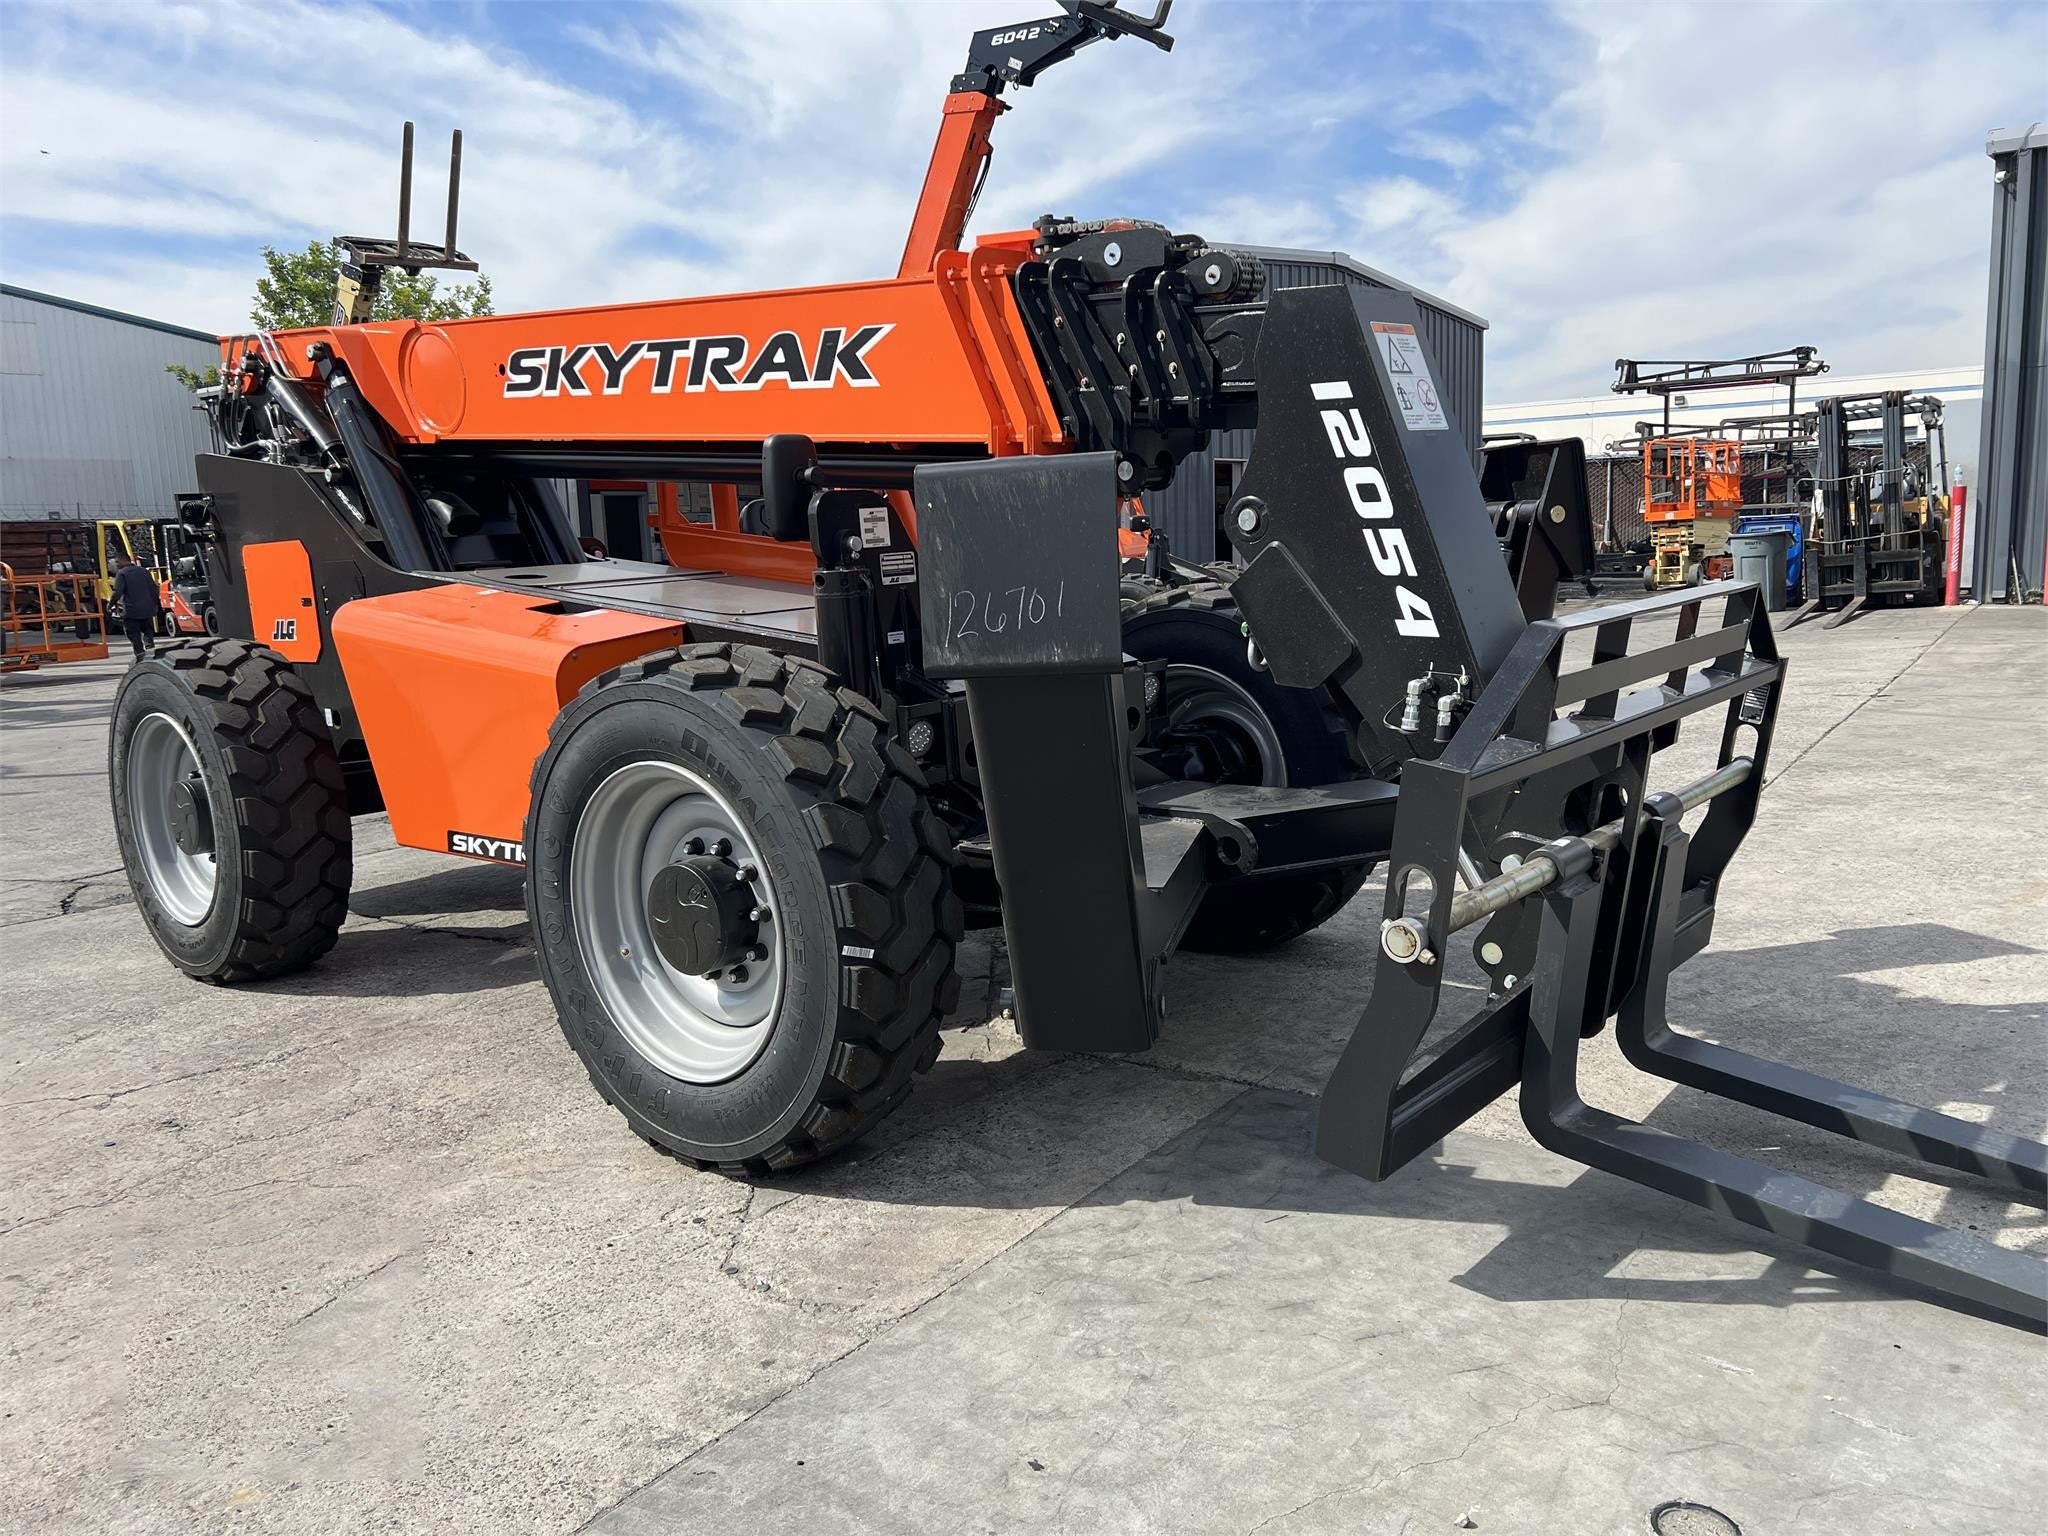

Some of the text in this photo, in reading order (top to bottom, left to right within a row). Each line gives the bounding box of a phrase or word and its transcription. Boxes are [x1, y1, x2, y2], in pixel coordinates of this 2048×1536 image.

[991, 27, 1041, 46] 6042
[503, 323, 897, 399] SKYTRAK
[1310, 380, 1441, 639] 12054
[272, 618, 297, 641] JLG
[943, 580, 1065, 648] 126701
